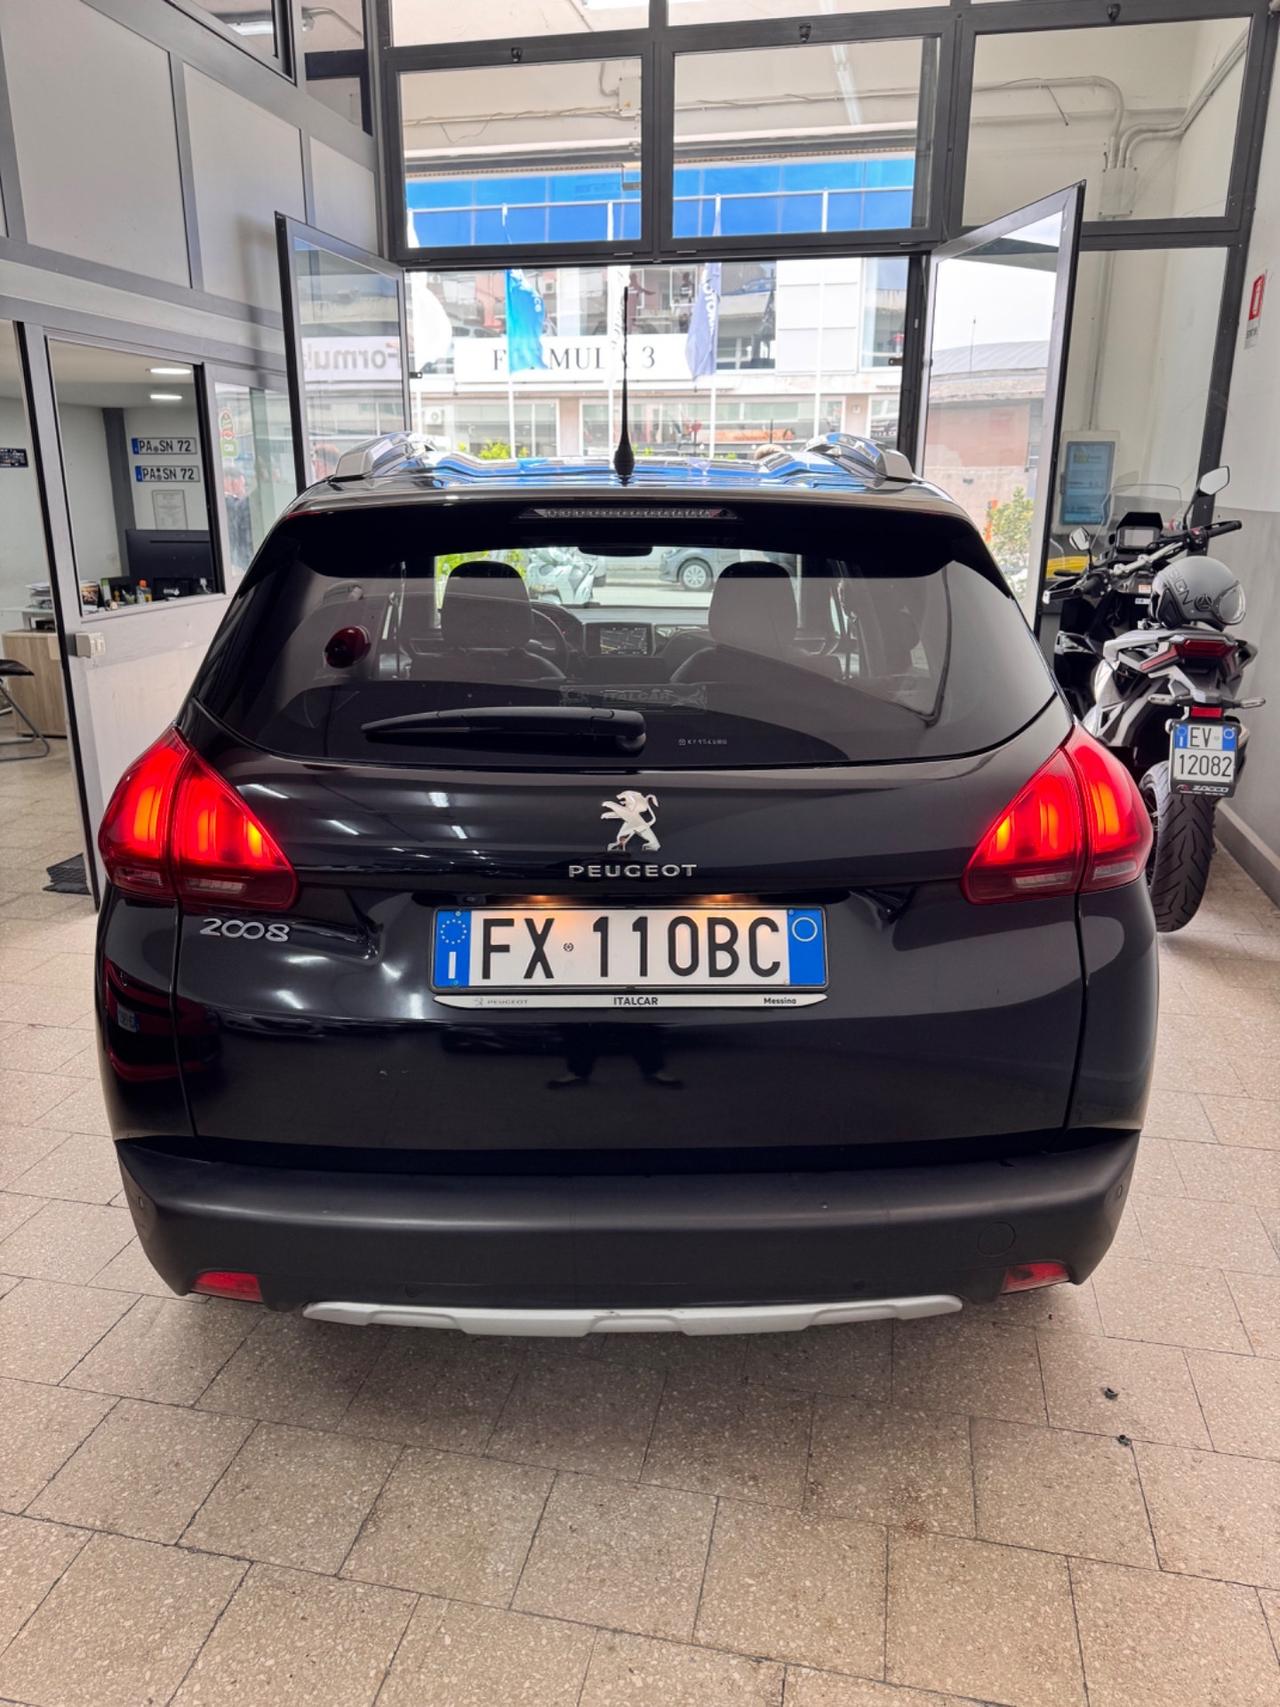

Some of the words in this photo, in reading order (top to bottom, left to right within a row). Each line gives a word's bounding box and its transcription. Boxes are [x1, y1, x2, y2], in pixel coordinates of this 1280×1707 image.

[493, 347, 631, 370] FMUL
[642, 345, 656, 369] 3
[178, 440, 191, 453] 72
[181, 468, 195, 480] 72
[1190, 726, 1212, 748] EV
[1179, 754, 1232, 777] 12082
[568, 864, 697, 878] PEUGEOT
[200, 917, 290, 942] 2008
[482, 918, 555, 979] FX
[593, 915, 781, 978] 110BC
[613, 997, 658, 1006] ITALCAR
